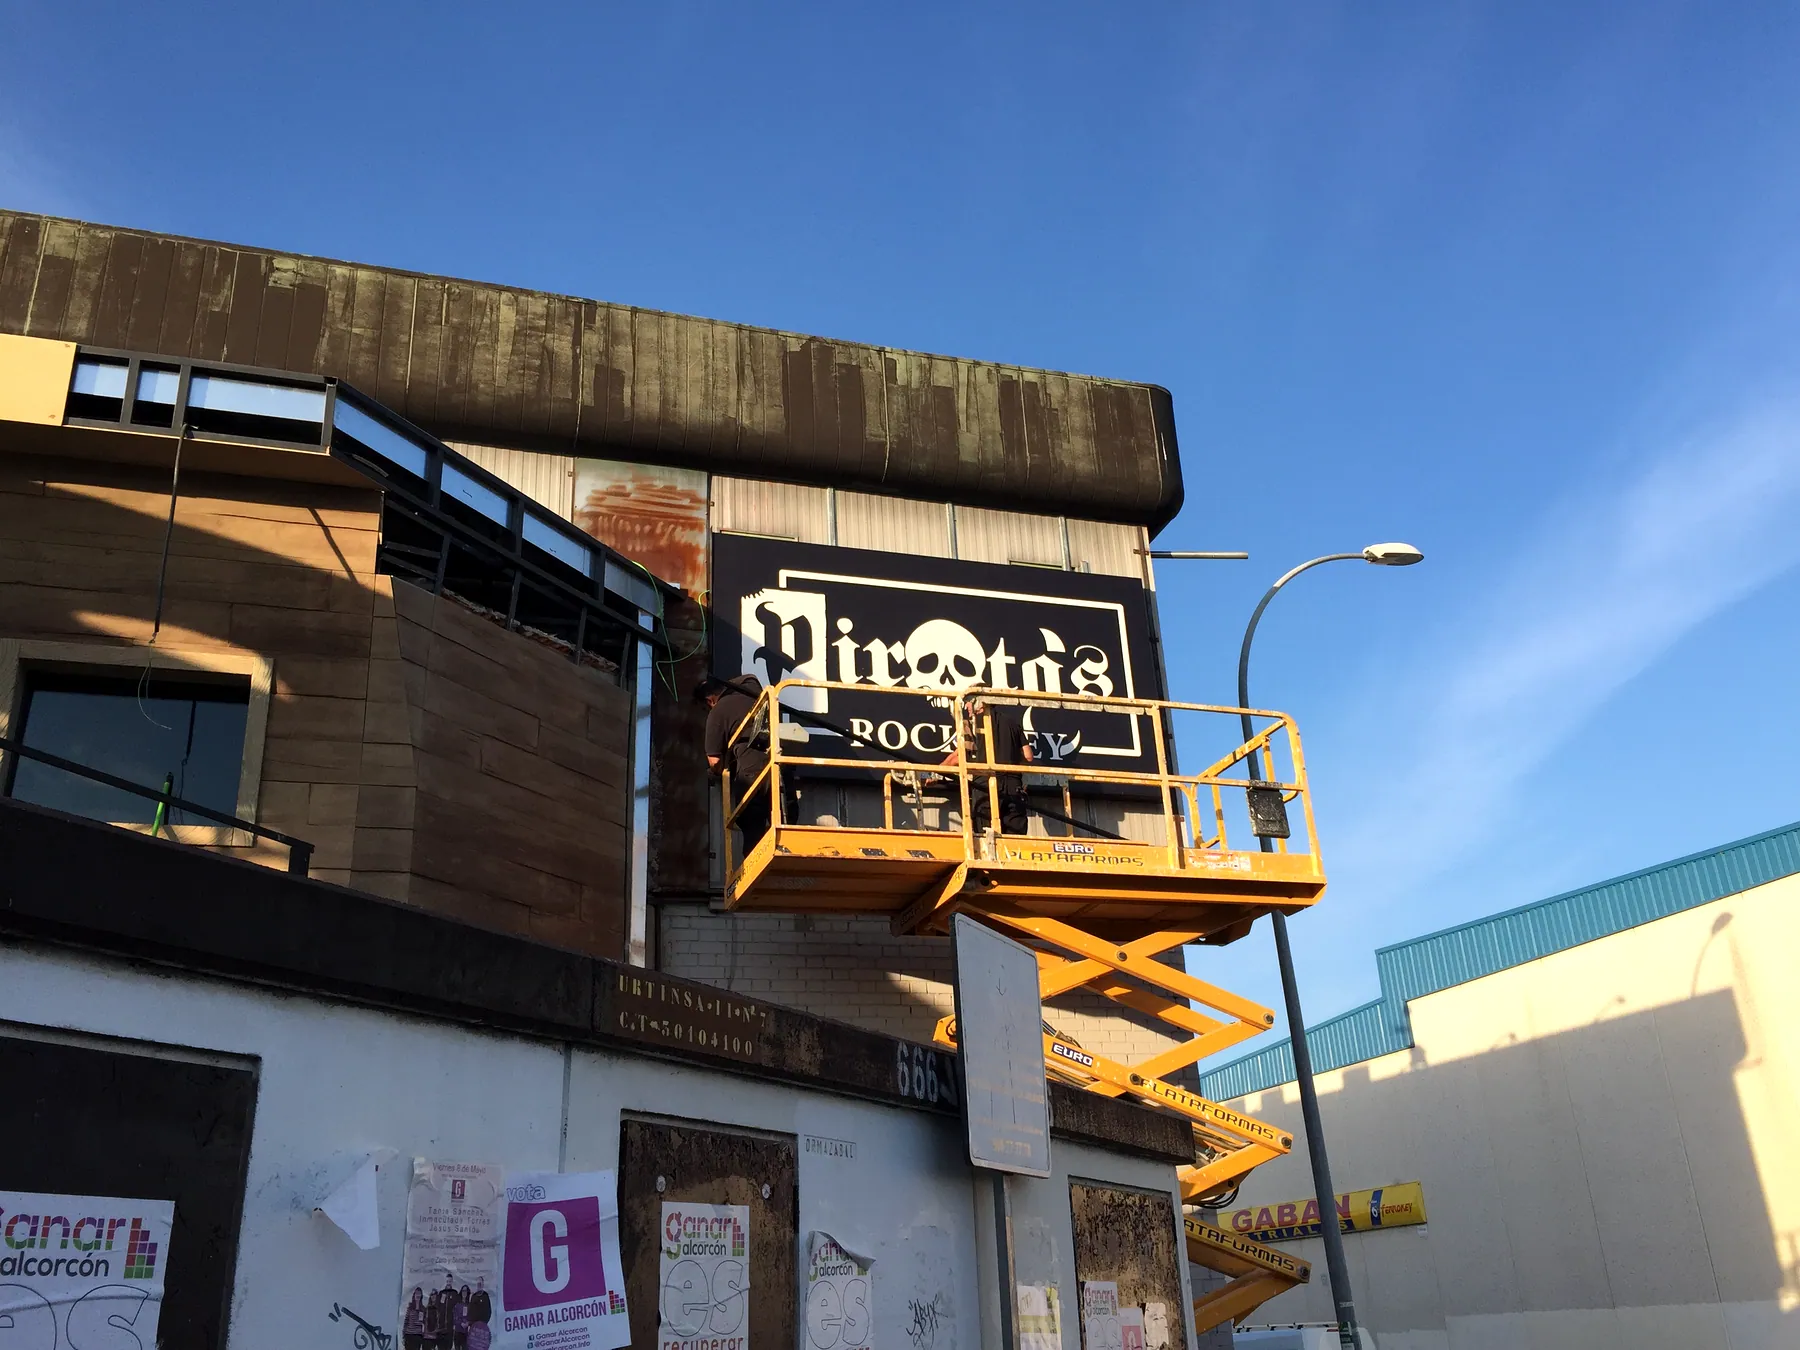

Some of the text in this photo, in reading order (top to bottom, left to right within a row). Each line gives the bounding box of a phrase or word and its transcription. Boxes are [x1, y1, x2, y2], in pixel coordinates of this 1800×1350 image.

[1053, 843, 1095, 855] EURO
[1053, 1043, 1093, 1066] EURO
[897, 1041, 938, 1103] 666
[506, 1183, 546, 1202] vota
[0, 1206, 127, 1252] anar
[529, 1208, 571, 1294] G
[682, 1239, 727, 1256] alcorcón
[0, 1250, 110, 1277] alcorcón
[819, 1261, 854, 1277] alcorcón
[504, 1299, 607, 1332] GANAR ALCORCÓN
[535, 1331, 557, 1340] Ganar
